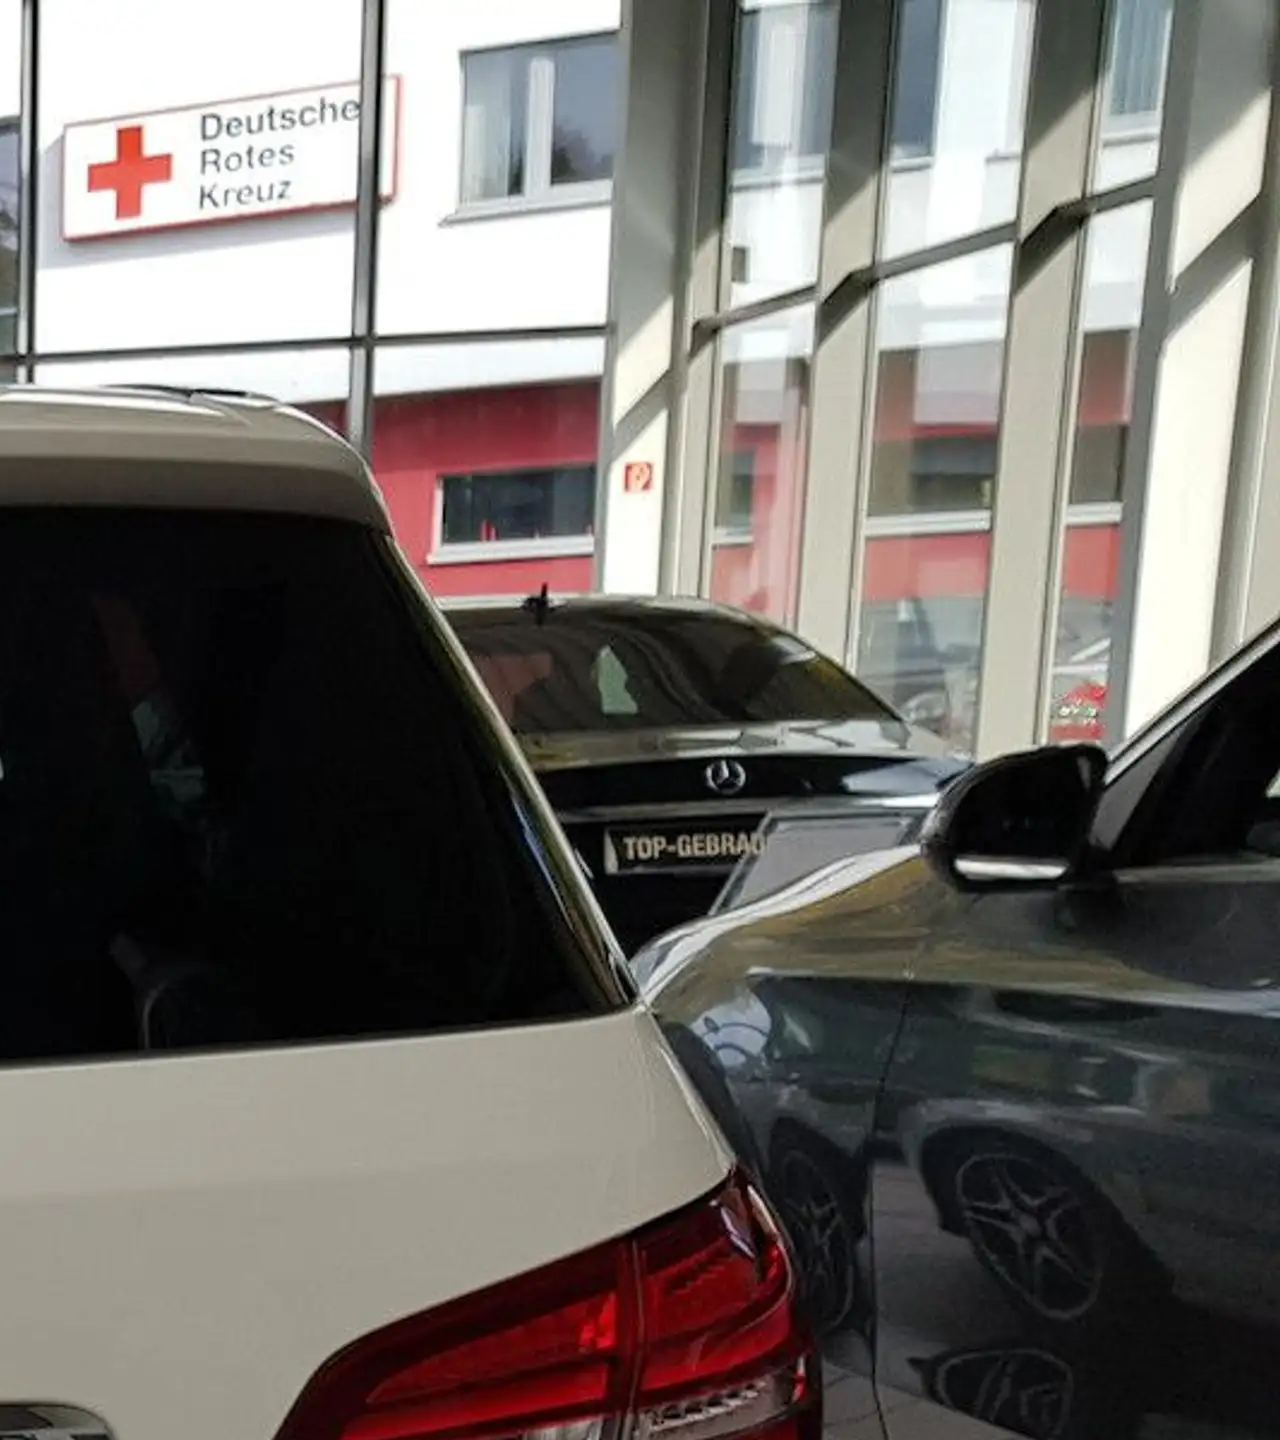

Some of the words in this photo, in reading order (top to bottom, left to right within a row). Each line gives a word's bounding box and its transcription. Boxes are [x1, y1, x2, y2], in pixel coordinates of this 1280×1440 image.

[199, 97, 360, 141] Deutsche
[199, 144, 295, 176] Rotes
[198, 179, 292, 210] Kreuz
[622, 832, 766, 861] TOP-GEBRAU
